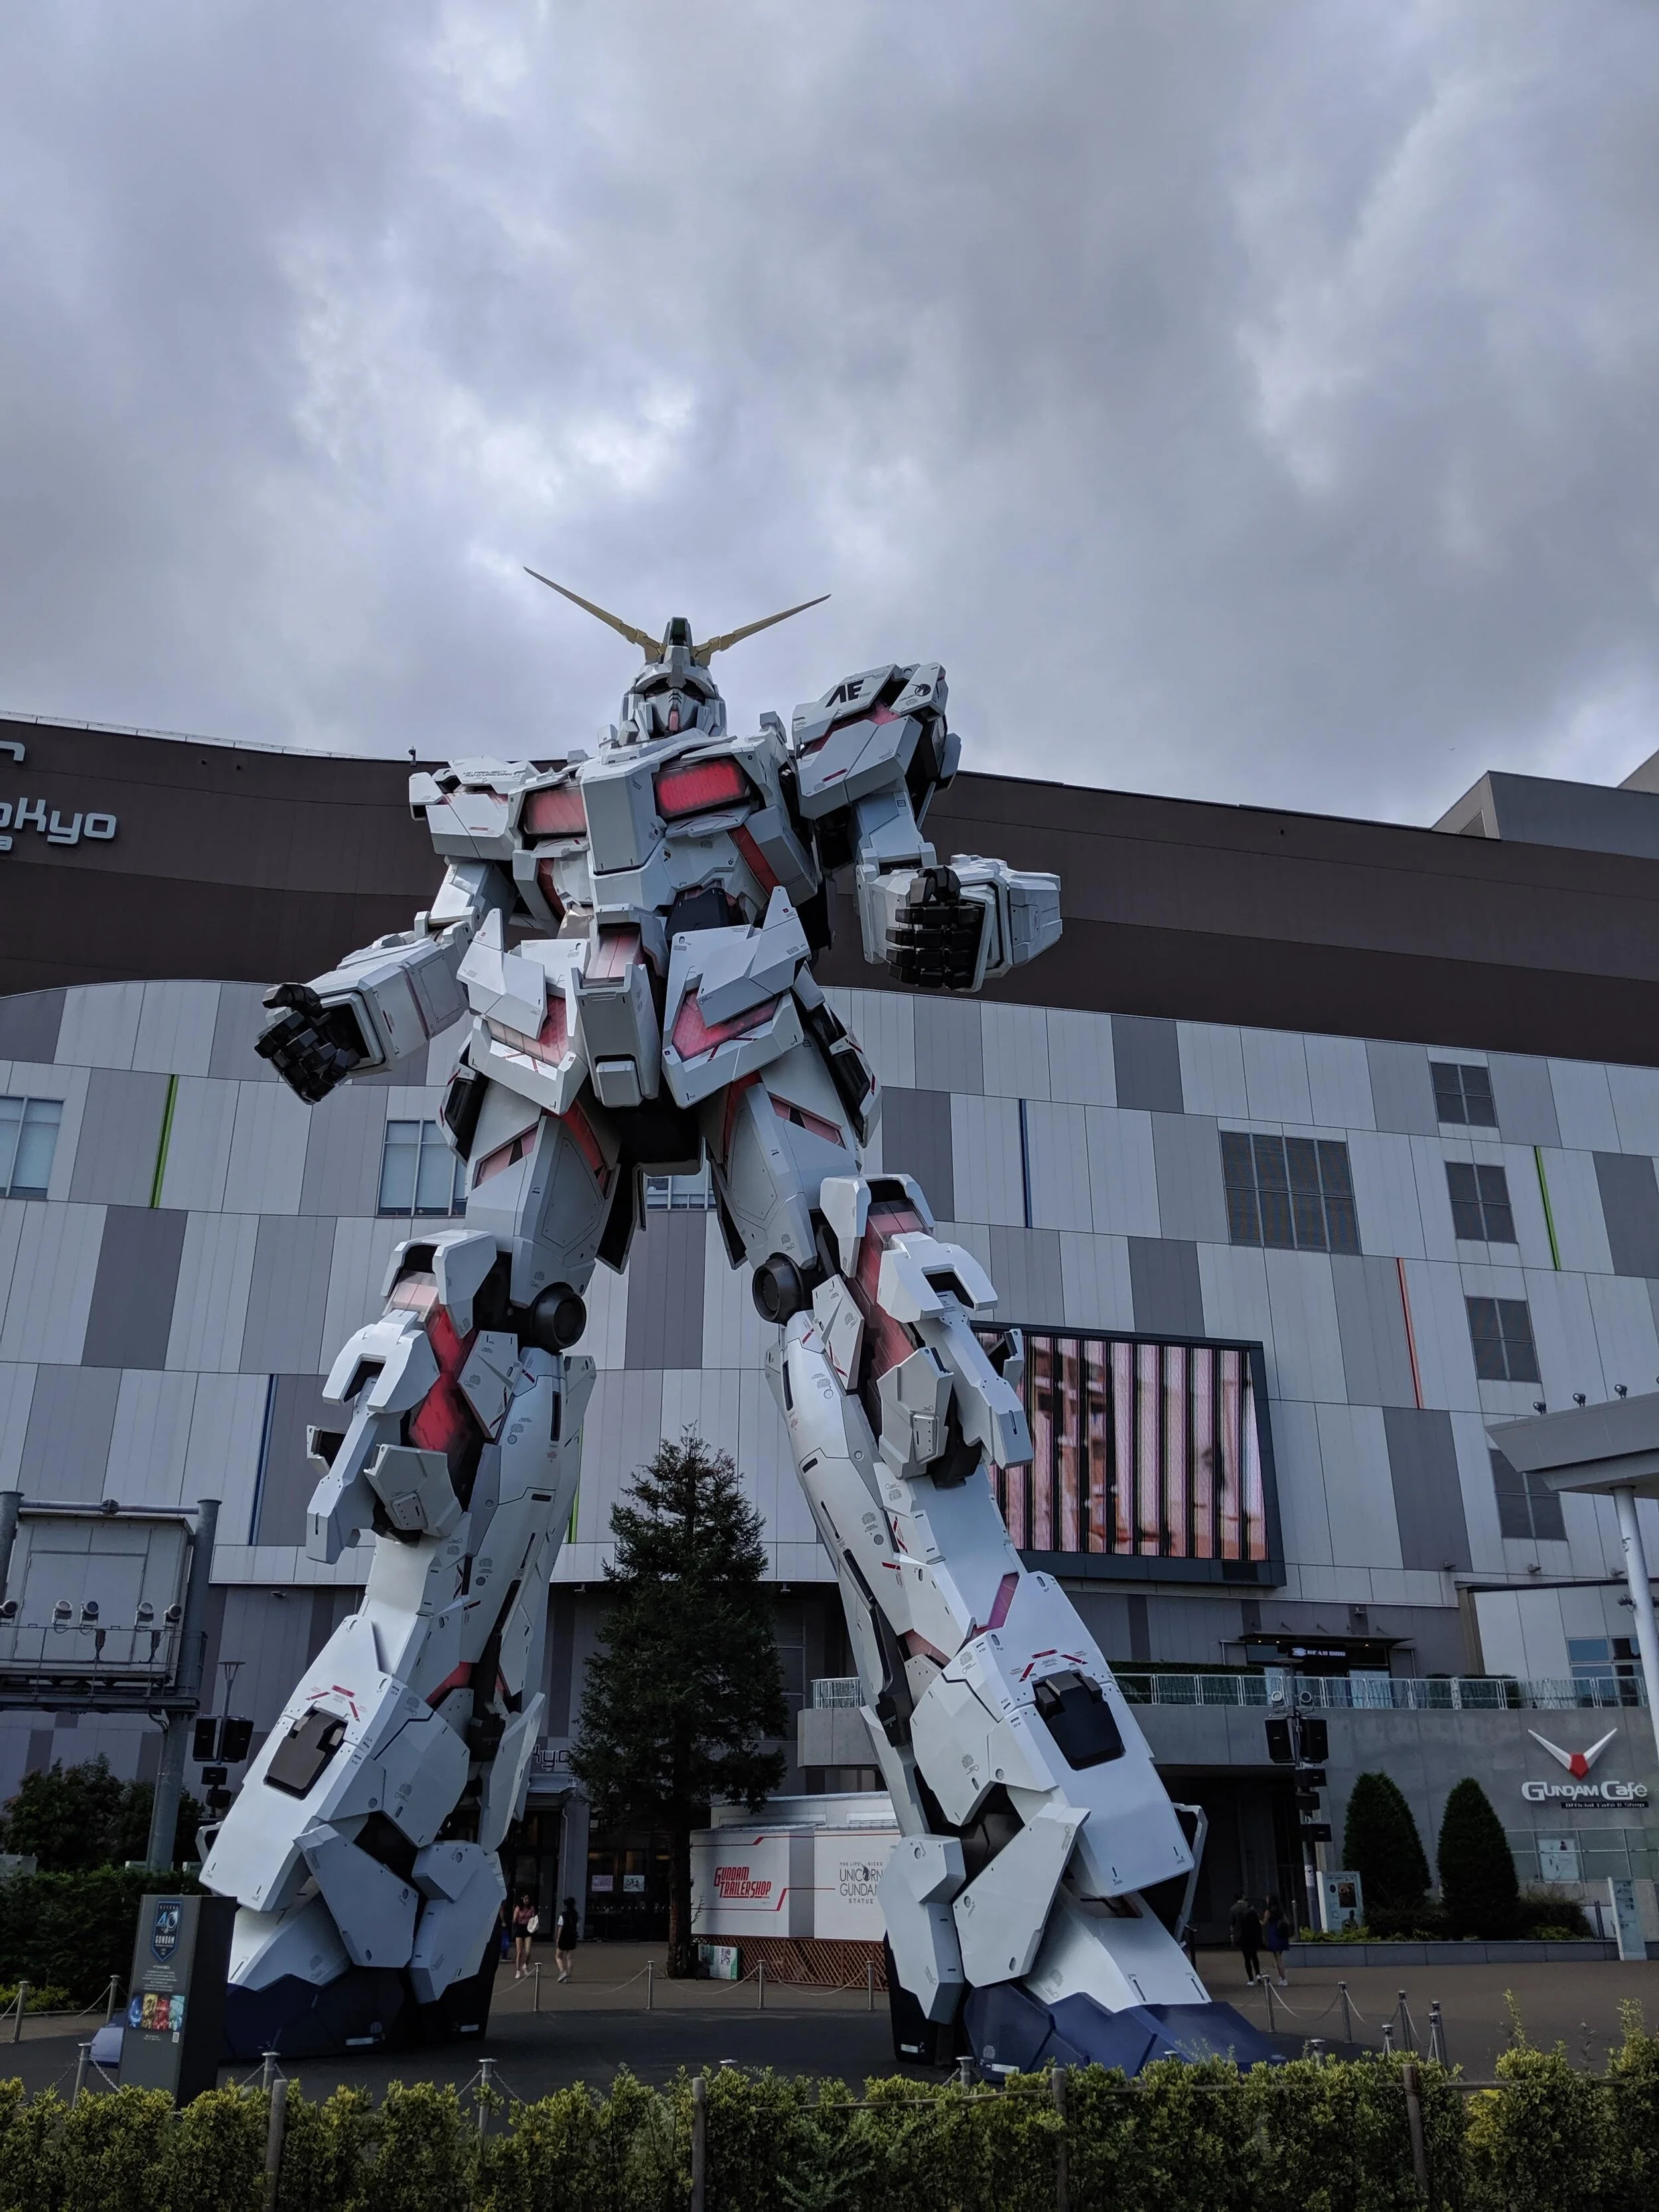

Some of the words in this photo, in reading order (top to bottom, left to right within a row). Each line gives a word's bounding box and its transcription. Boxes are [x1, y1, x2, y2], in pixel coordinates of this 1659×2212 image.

[825, 679, 865, 708] AE
[1522, 1781, 1599, 1801] GUNDAM
[1601, 1781, 1648, 1801] Café
[714, 1866, 750, 1887] GUNDAM
[839, 1868, 883, 1882] UNICORN
[839, 1883, 877, 1896] GUNDA
[155, 1935, 175, 1945] GUNDAM
